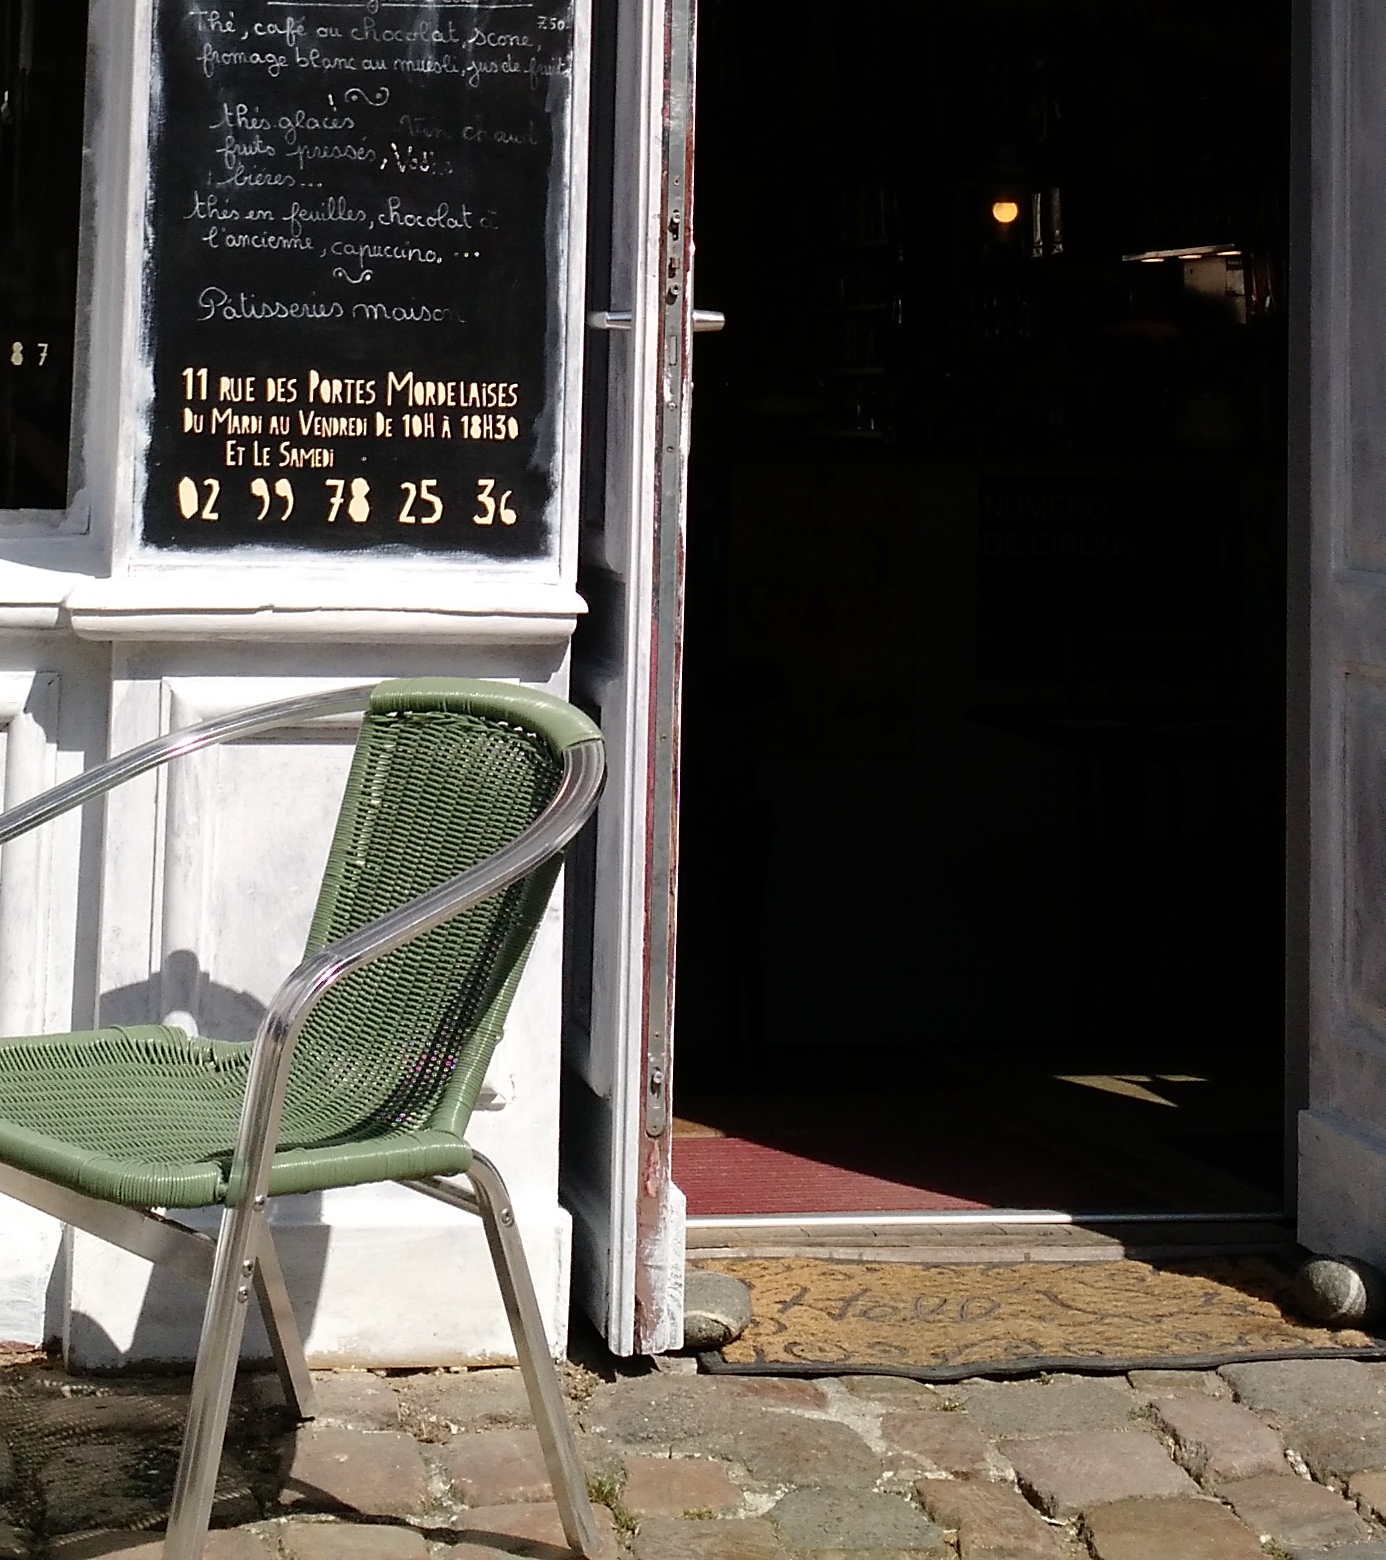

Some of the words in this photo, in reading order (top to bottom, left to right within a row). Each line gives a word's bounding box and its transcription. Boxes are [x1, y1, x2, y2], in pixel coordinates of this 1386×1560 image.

[378, 196, 472, 231] chocolat
[182, 368, 208, 401] 11
[220, 377, 256, 402] RUE
[267, 378, 297, 402] DES
[309, 370, 375, 406] PORTES
[387, 371, 518, 408] MORDELAISES
[183, 408, 203, 433] DU
[211, 409, 262, 436] MARDI
[269, 415, 289, 436] AU
[299, 409, 367, 437] VENDREDI
[377, 411, 392, 438] DE
[403, 412, 434, 438] 10H
[461, 414, 518, 439] 18H30
[226, 440, 246, 466] ET
[253, 442, 271, 467] LE
[278, 442, 334, 468] SAMEDI
[178, 477, 220, 519] 02
[250, 478, 294, 520] 99
[326, 478, 370, 523] 78
[399, 479, 443, 523] 25
[473, 479, 516, 524] 36
